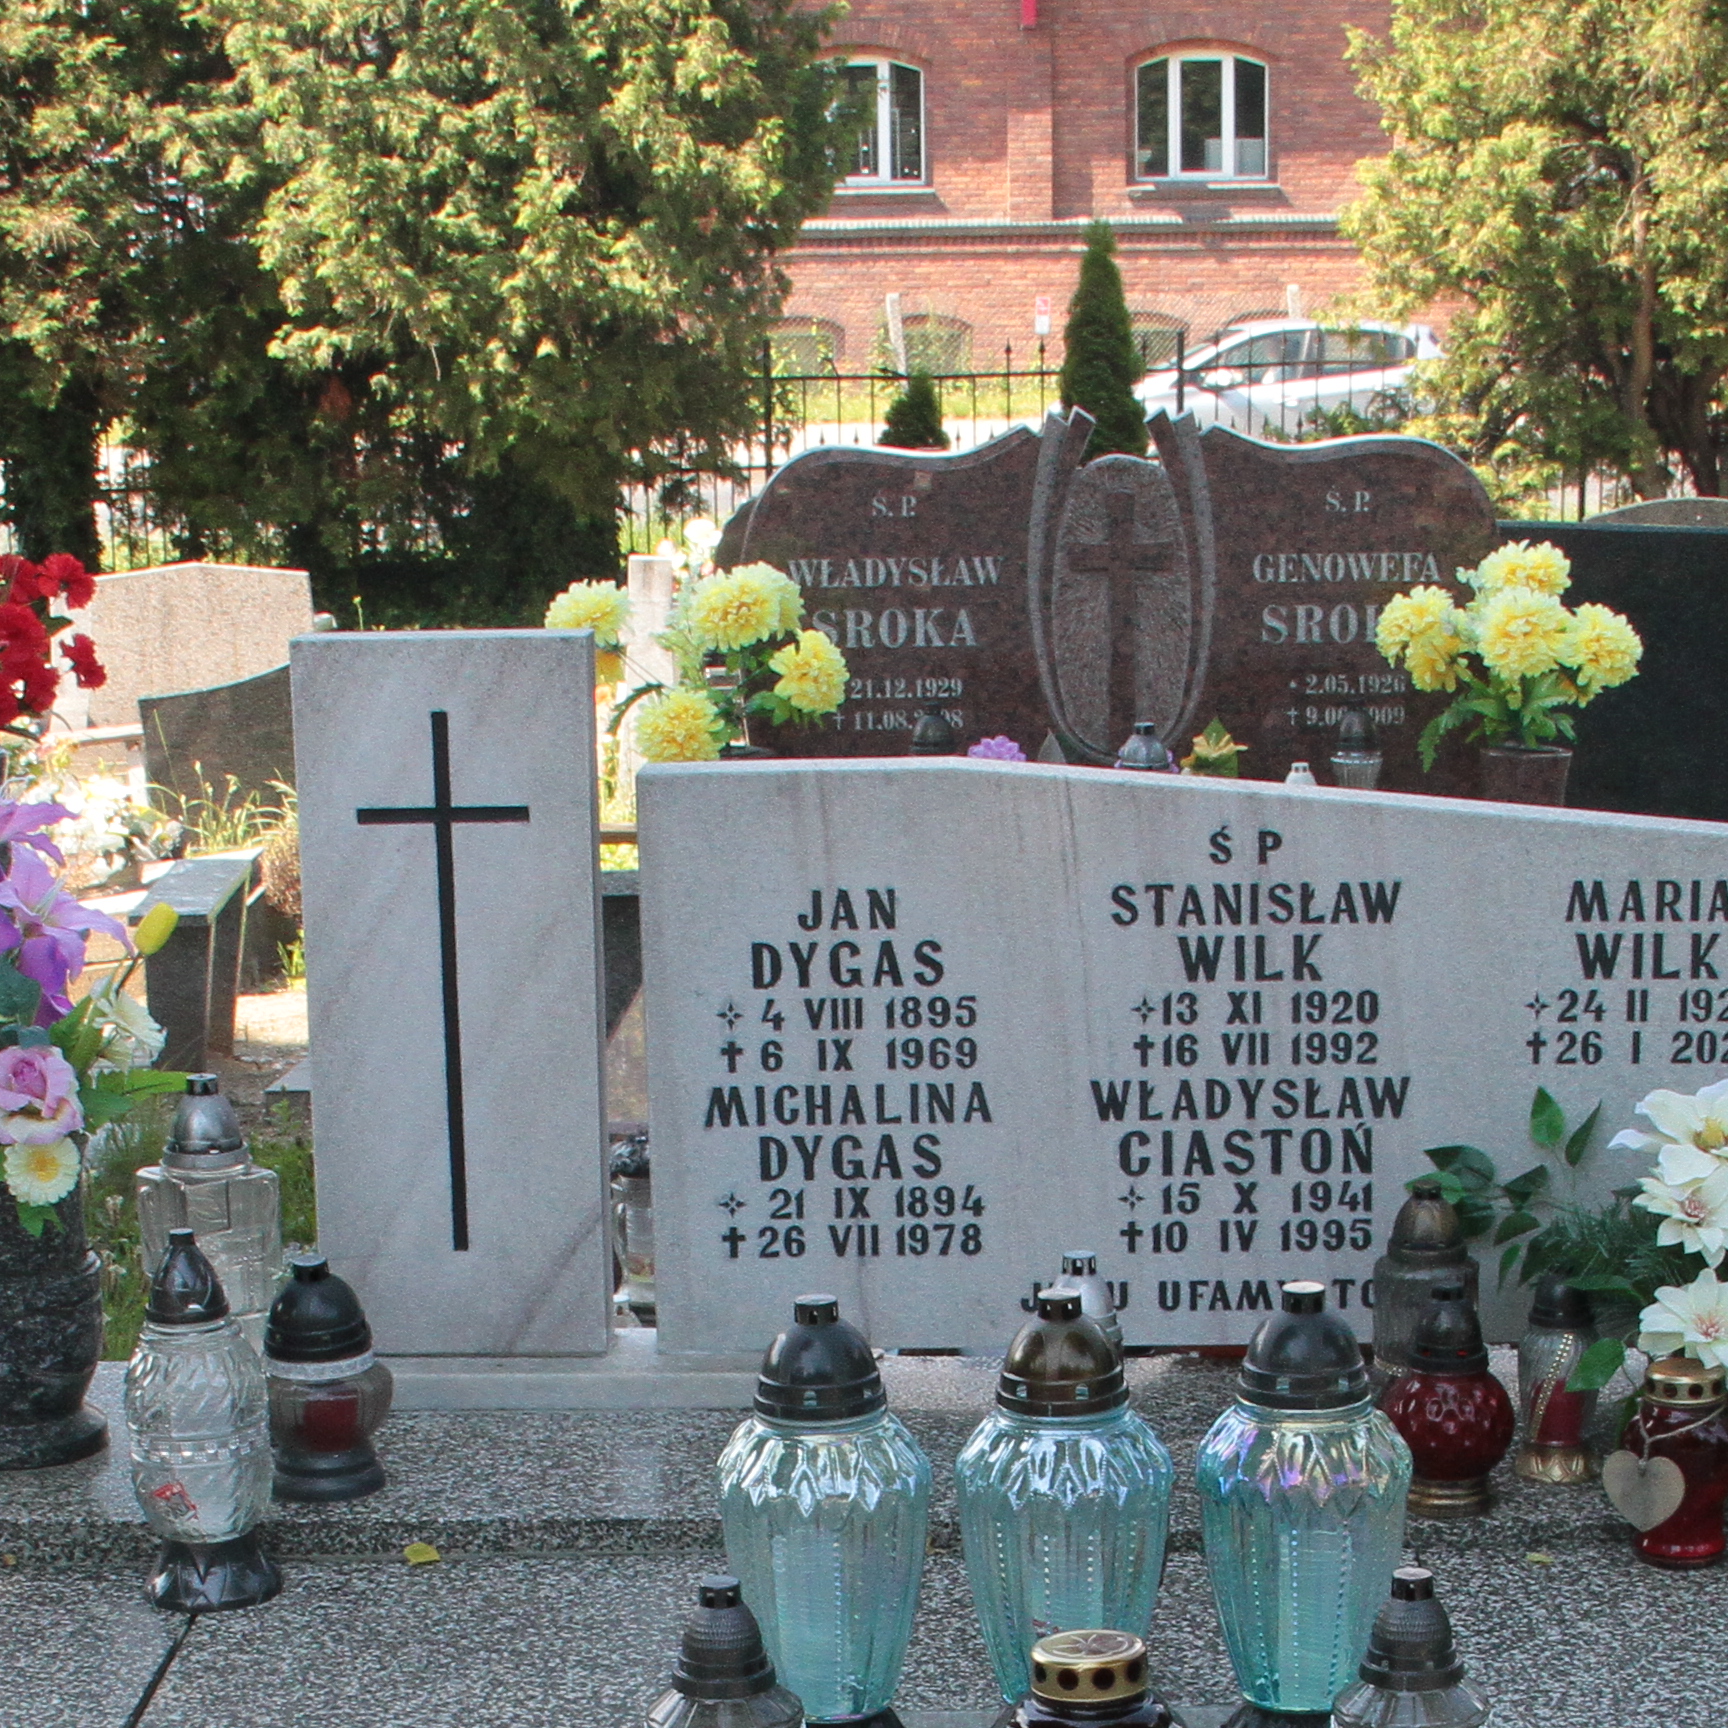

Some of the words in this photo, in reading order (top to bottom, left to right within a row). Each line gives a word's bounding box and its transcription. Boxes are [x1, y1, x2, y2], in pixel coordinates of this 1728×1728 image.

[788, 555, 1004, 588] WŁADYSŁAW
[1252, 551, 1442, 583] GENOWEFA
[812, 608, 979, 649] SROKA
[850, 677, 964, 700] 21.12.1929
[1209, 825, 1233, 865] Ś
[1257, 830, 1283, 865] P
[797, 887, 898, 931] JAN
[1110, 880, 1401, 926] STANISŁAW
[751, 939, 945, 990] DYGAS
[1177, 934, 1323, 983] WILK
[1575, 932, 1721, 980] WILK
[761, 998, 785, 1032] 4
[803, 997, 864, 1031] VIII
[885, 995, 978, 1029] 1895
[1161, 990, 1198, 1026] 13
[1226, 990, 1262, 1025] XI
[1290, 989, 1380, 1025] 1920
[1557, 988, 1606, 1023] 24
[1626, 988, 1649, 1023] II
[761, 1040, 784, 1072] 6
[817, 1039, 854, 1071] IX
[886, 1037, 978, 1070] 1969
[1162, 1032, 1198, 1067] 16
[1221, 1032, 1270, 1066] VII
[1290, 1031, 1379, 1066] 1992
[1556, 1030, 1604, 1065] 26
[704, 1081, 993, 1128] MICHALINA
[1090, 1076, 1411, 1122] WŁADYSŁAW
[758, 1133, 943, 1182] DYGAS
[1118, 1122, 1374, 1177] CIASTOŃ
[769, 1188, 805, 1220] 21
[834, 1187, 871, 1219] IX
[895, 1185, 986, 1218] 1894
[1162, 1181, 1200, 1215] 15
[1232, 1181, 1259, 1215] X
[1291, 1180, 1373, 1214] 1941
[758, 1225, 807, 1258] 26
[828, 1225, 880, 1258] VII
[895, 1223, 984, 1256] 1978
[1152, 1220, 1189, 1253] 10
[1219, 1219, 1259, 1253] IV
[1280, 1219, 1373, 1253] 1995
